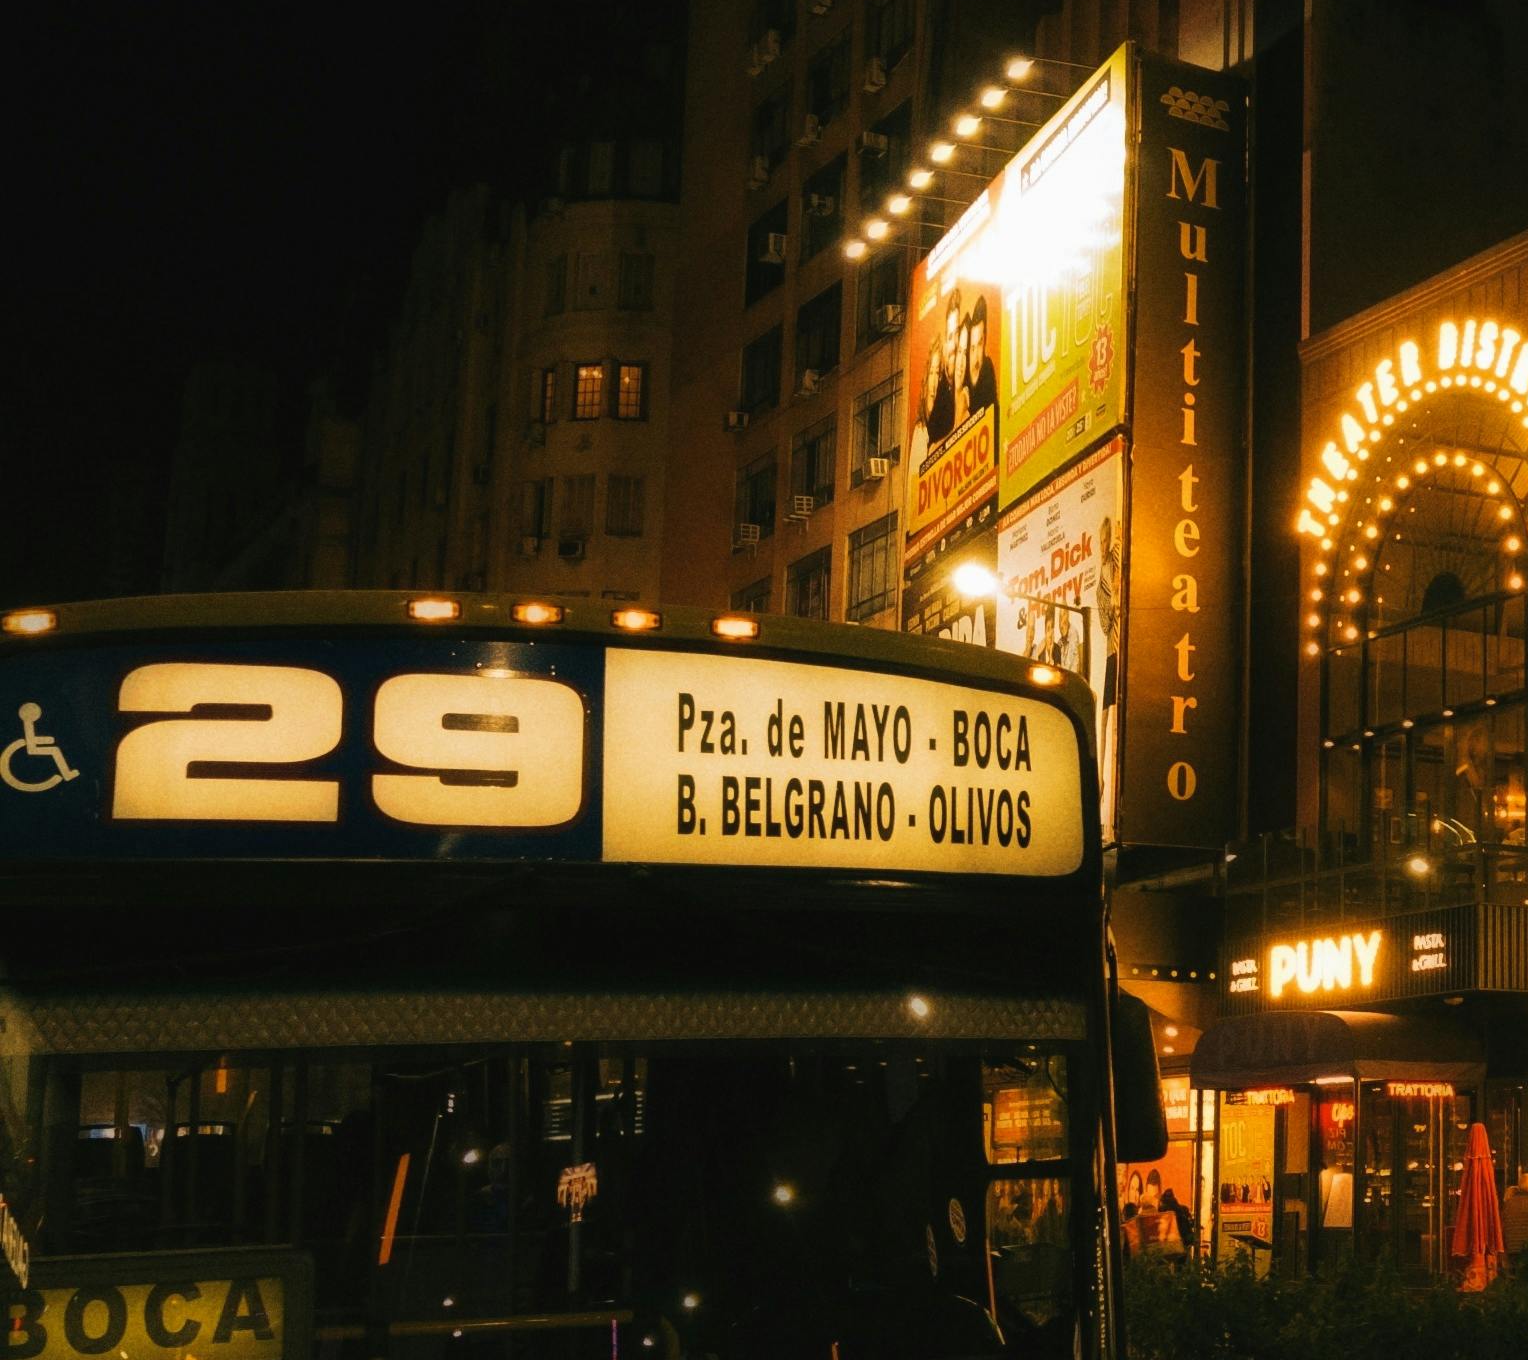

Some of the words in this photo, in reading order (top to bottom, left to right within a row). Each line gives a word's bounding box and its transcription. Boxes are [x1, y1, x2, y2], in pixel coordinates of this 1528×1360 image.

[918, 425, 989, 516] DIVORCIO
[1165, 145, 1222, 802] Multiteatro
[1296, 340, 1422, 538] THEATER
[1051, 532, 1092, 582] Dick
[112, 661, 585, 828] 29
[677, 692, 748, 755] Pza.
[768, 698, 805, 759] de
[824, 701, 911, 764] MAYO
[929, 737, 937, 750] -
[953, 709, 1032, 772] BOCA
[677, 774, 706, 836] B.
[722, 776, 896, 841] BELGRANO
[908, 814, 916, 828] -
[929, 784, 1032, 849] OLIVOS
[1270, 930, 1381, 997] PUNY
[1387, 1082, 1454, 1098] TRATTORIA
[0, 1280, 276, 1360] BOCA
